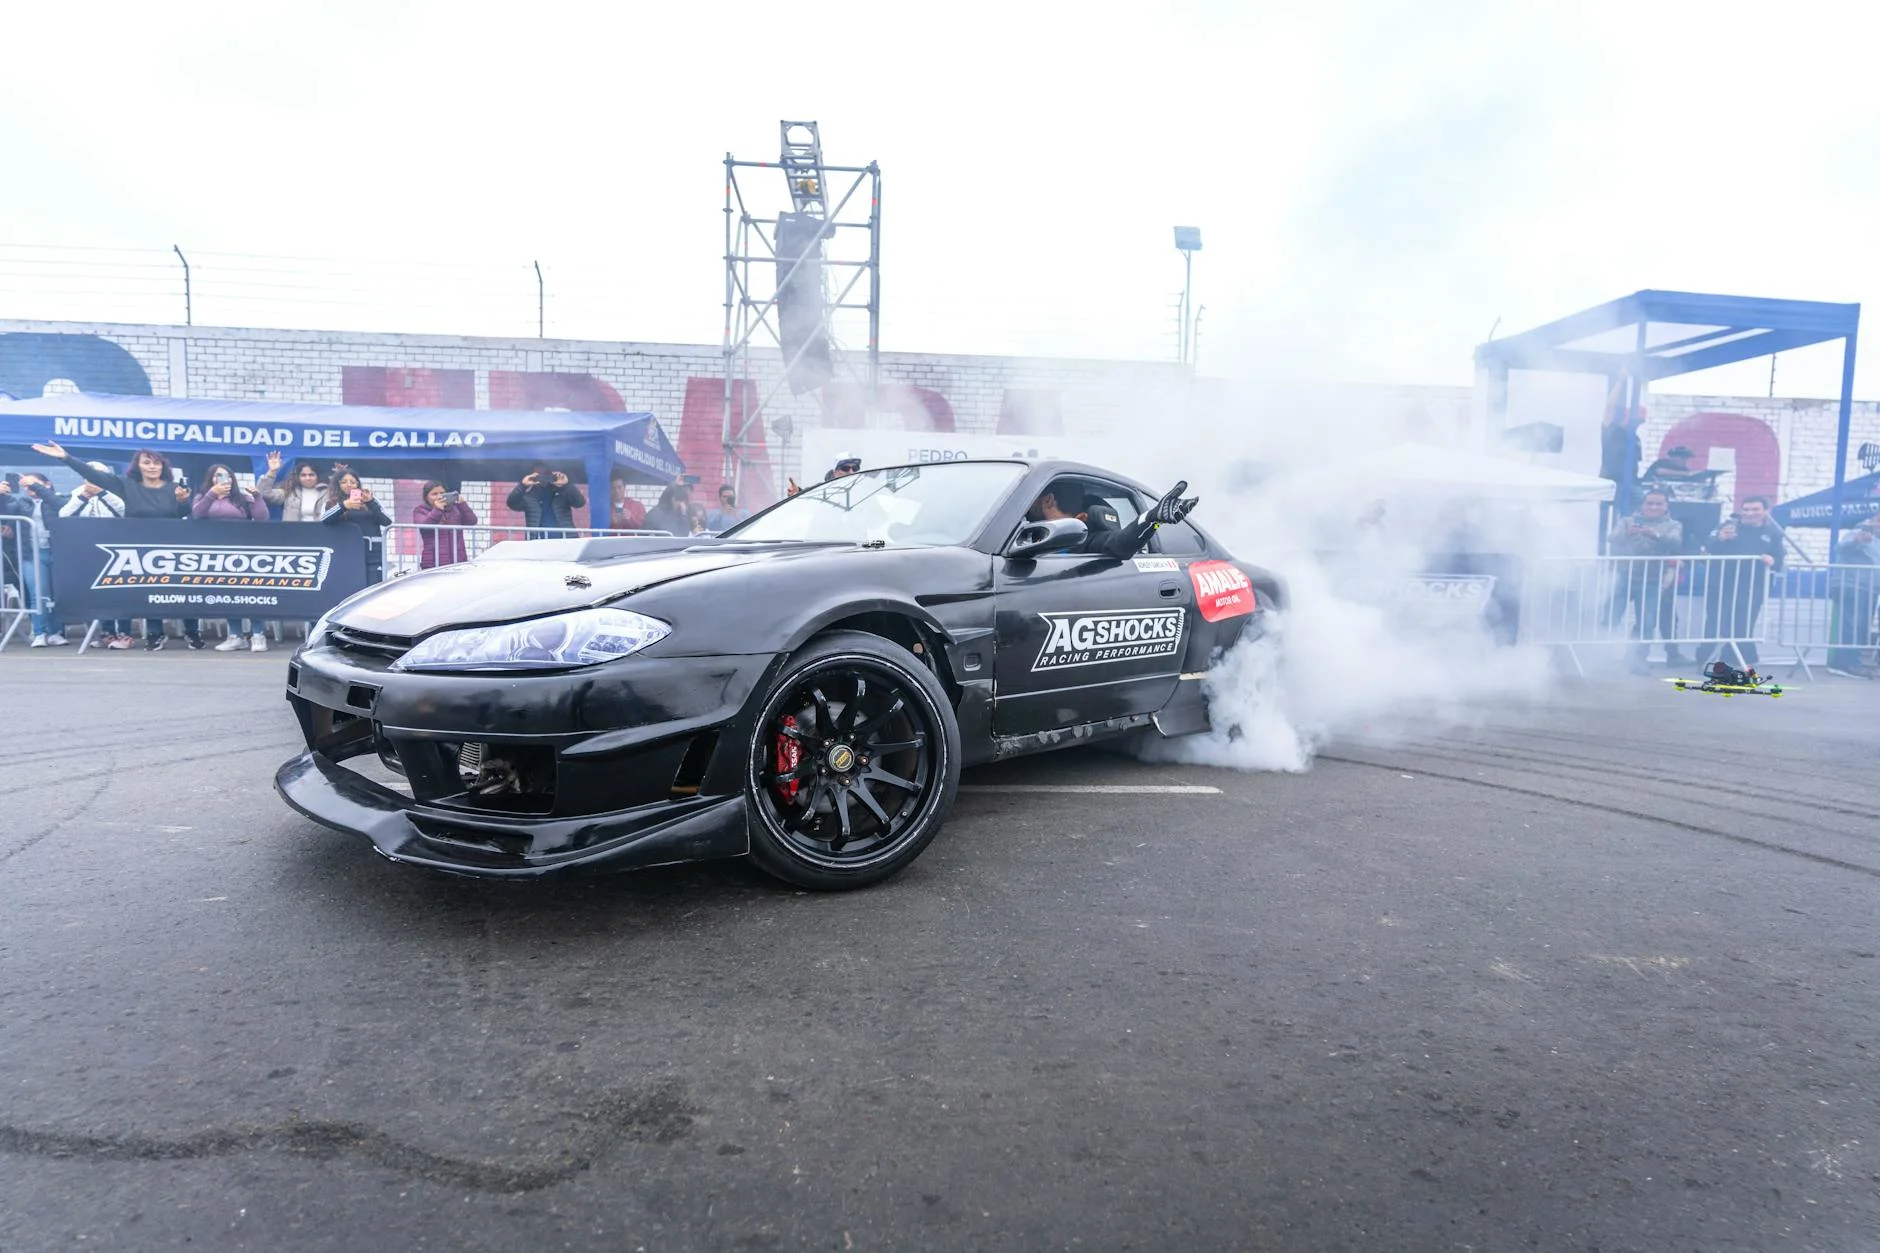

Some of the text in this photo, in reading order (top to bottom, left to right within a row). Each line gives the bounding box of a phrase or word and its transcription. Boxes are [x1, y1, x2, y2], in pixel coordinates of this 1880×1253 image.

[54, 416, 485, 447] MUNICIPALIDAD DEL CALLAO
[106, 549, 317, 576] AGSHOCKS
[102, 576, 313, 587] RACING PERFORMANCE
[148, 595, 278, 605] FOLLOW US @AG.SHOCKS
[1045, 617, 1177, 654] AGSHOCKS
[1039, 642, 1173, 666] RACING PERFORMANCE
